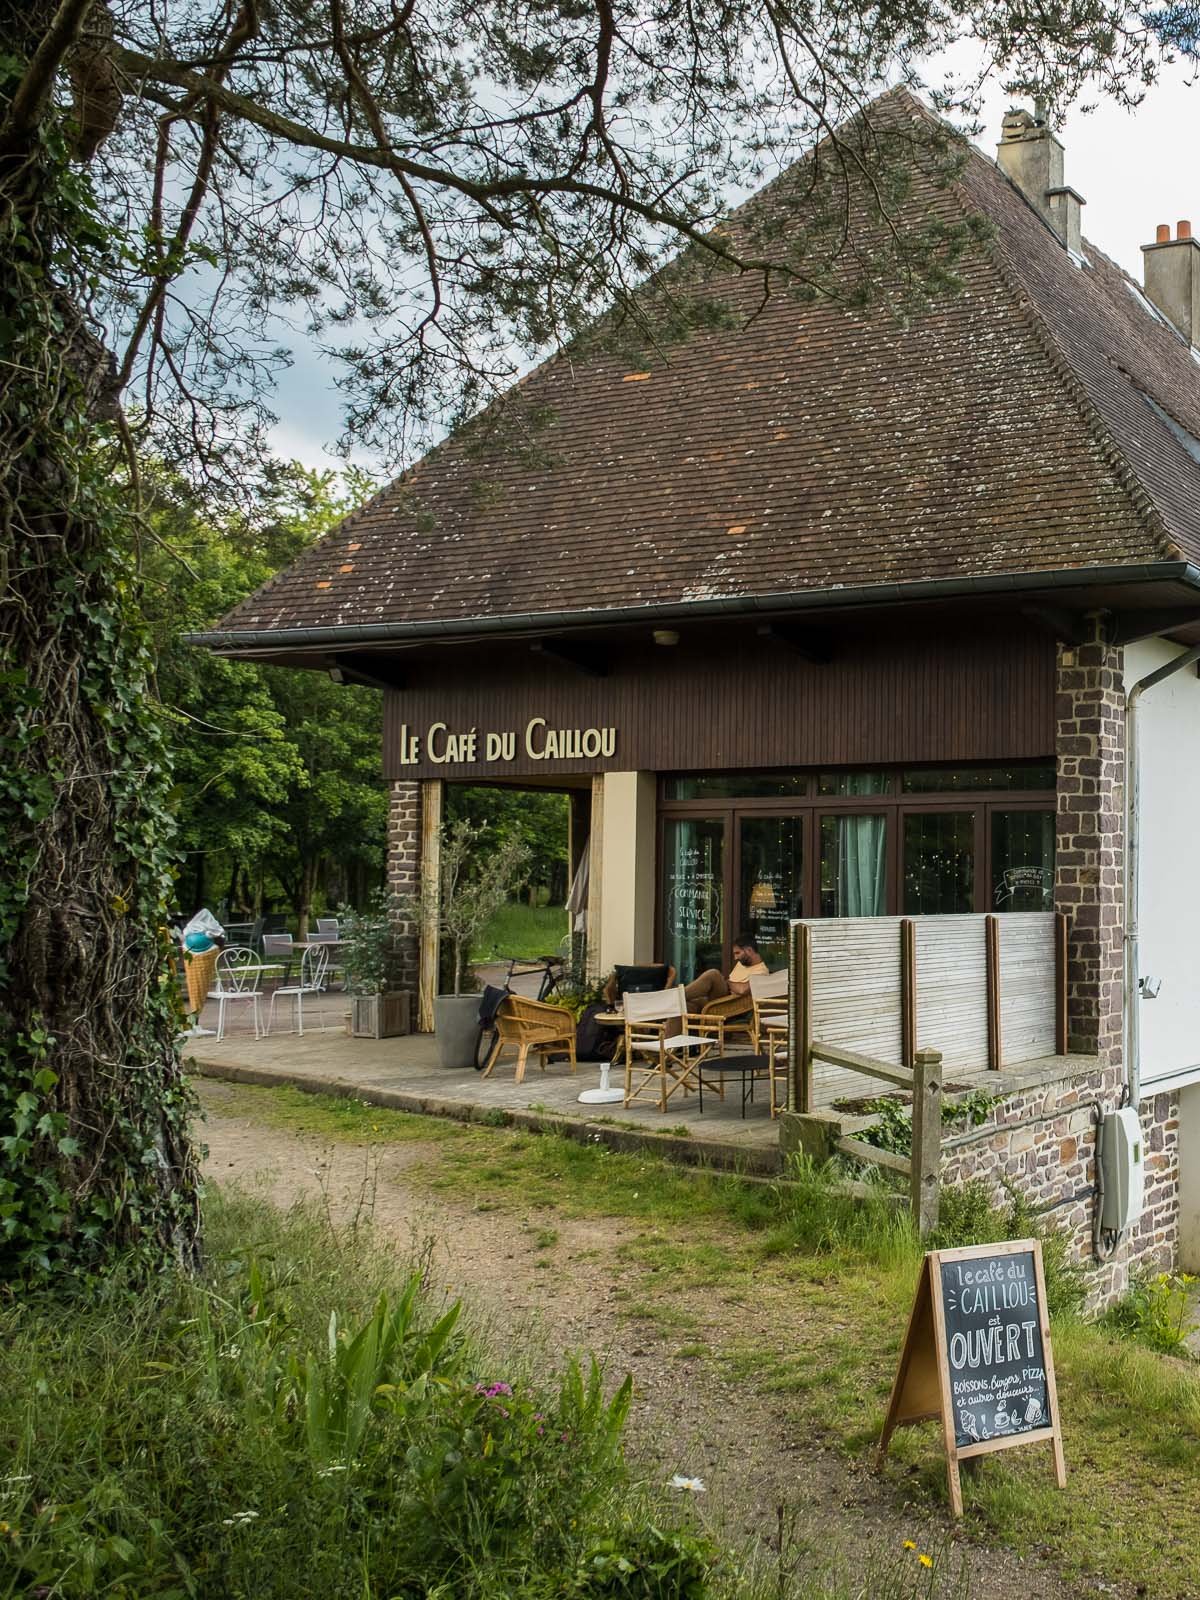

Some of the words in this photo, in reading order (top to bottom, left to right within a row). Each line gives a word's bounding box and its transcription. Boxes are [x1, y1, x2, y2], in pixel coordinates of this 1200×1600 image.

[486, 732, 516, 762] DU
[957, 1266, 974, 1286] le
[975, 1261, 1005, 1284] café
[1007, 1261, 1026, 1279] du
[961, 1280, 1028, 1314] CAILLOU
[988, 1314, 1001, 1326] est
[950, 1321, 1036, 1370] OUVERT
[956, 1396, 967, 1408] et
[968, 1393, 995, 1405] autres
